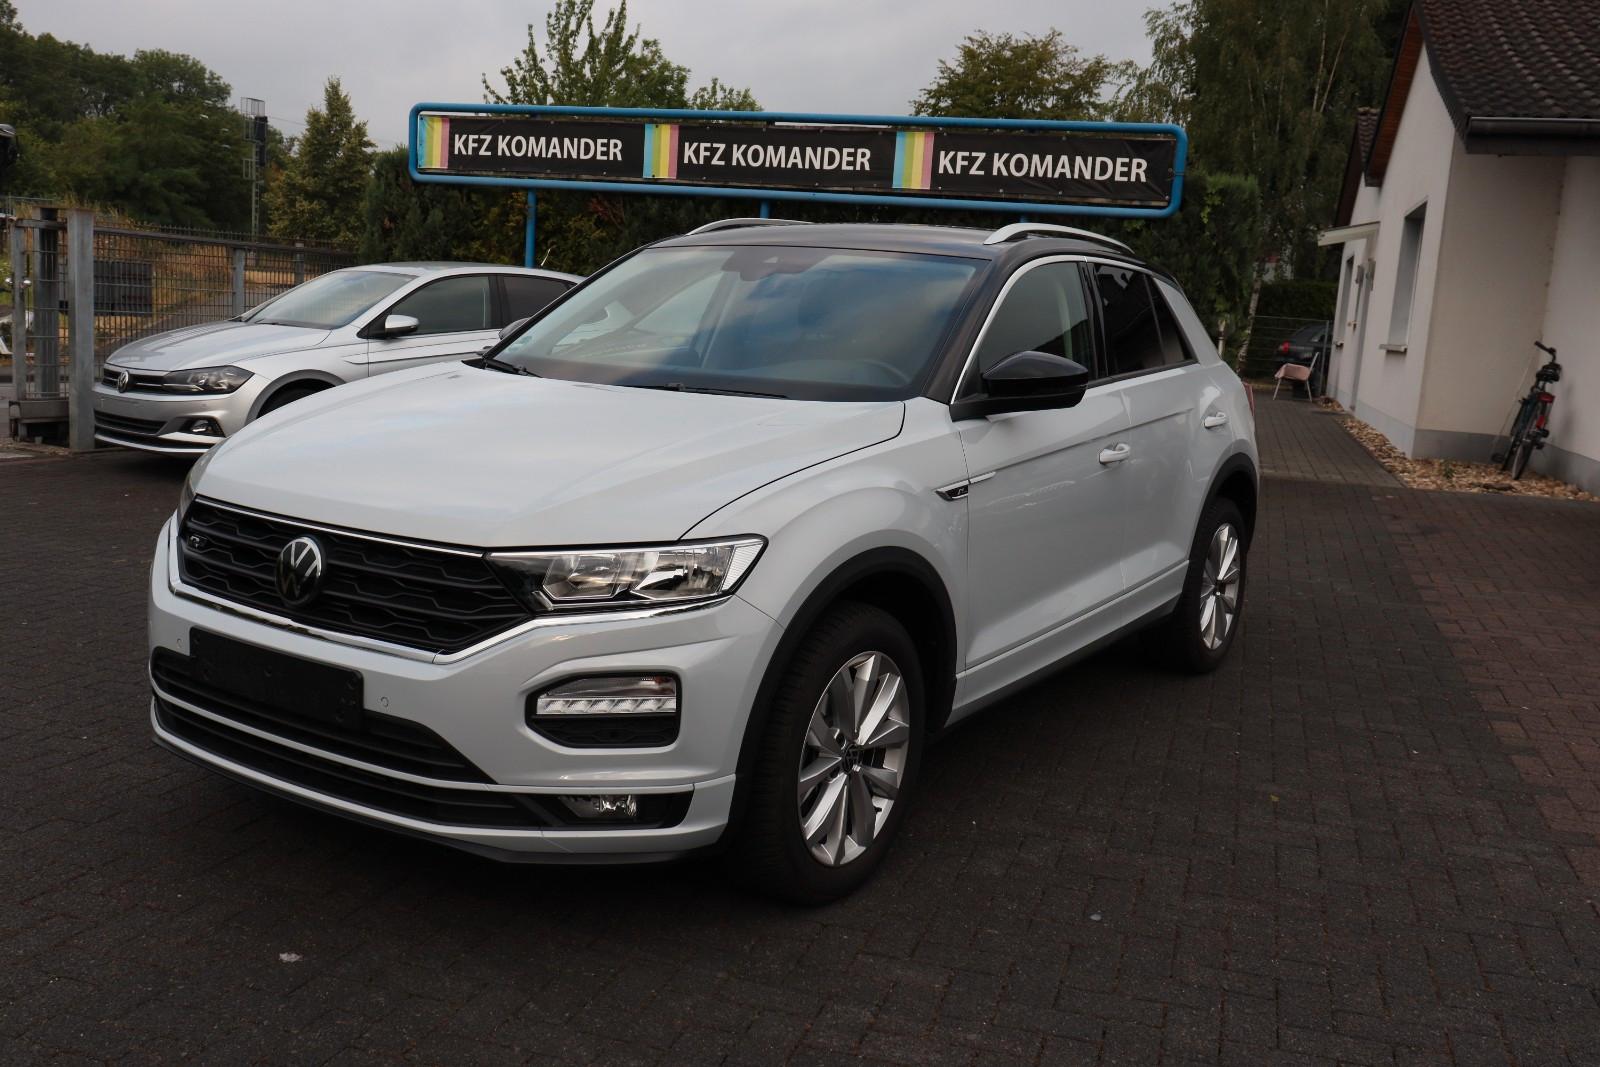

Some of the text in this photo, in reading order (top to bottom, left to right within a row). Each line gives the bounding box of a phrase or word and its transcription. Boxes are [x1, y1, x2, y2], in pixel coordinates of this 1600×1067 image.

[454, 134, 622, 161] KFZ KOMANDER
[683, 142, 870, 171] KFZ KOMANDER
[938, 151, 1147, 183] KFZ KOMANDER
